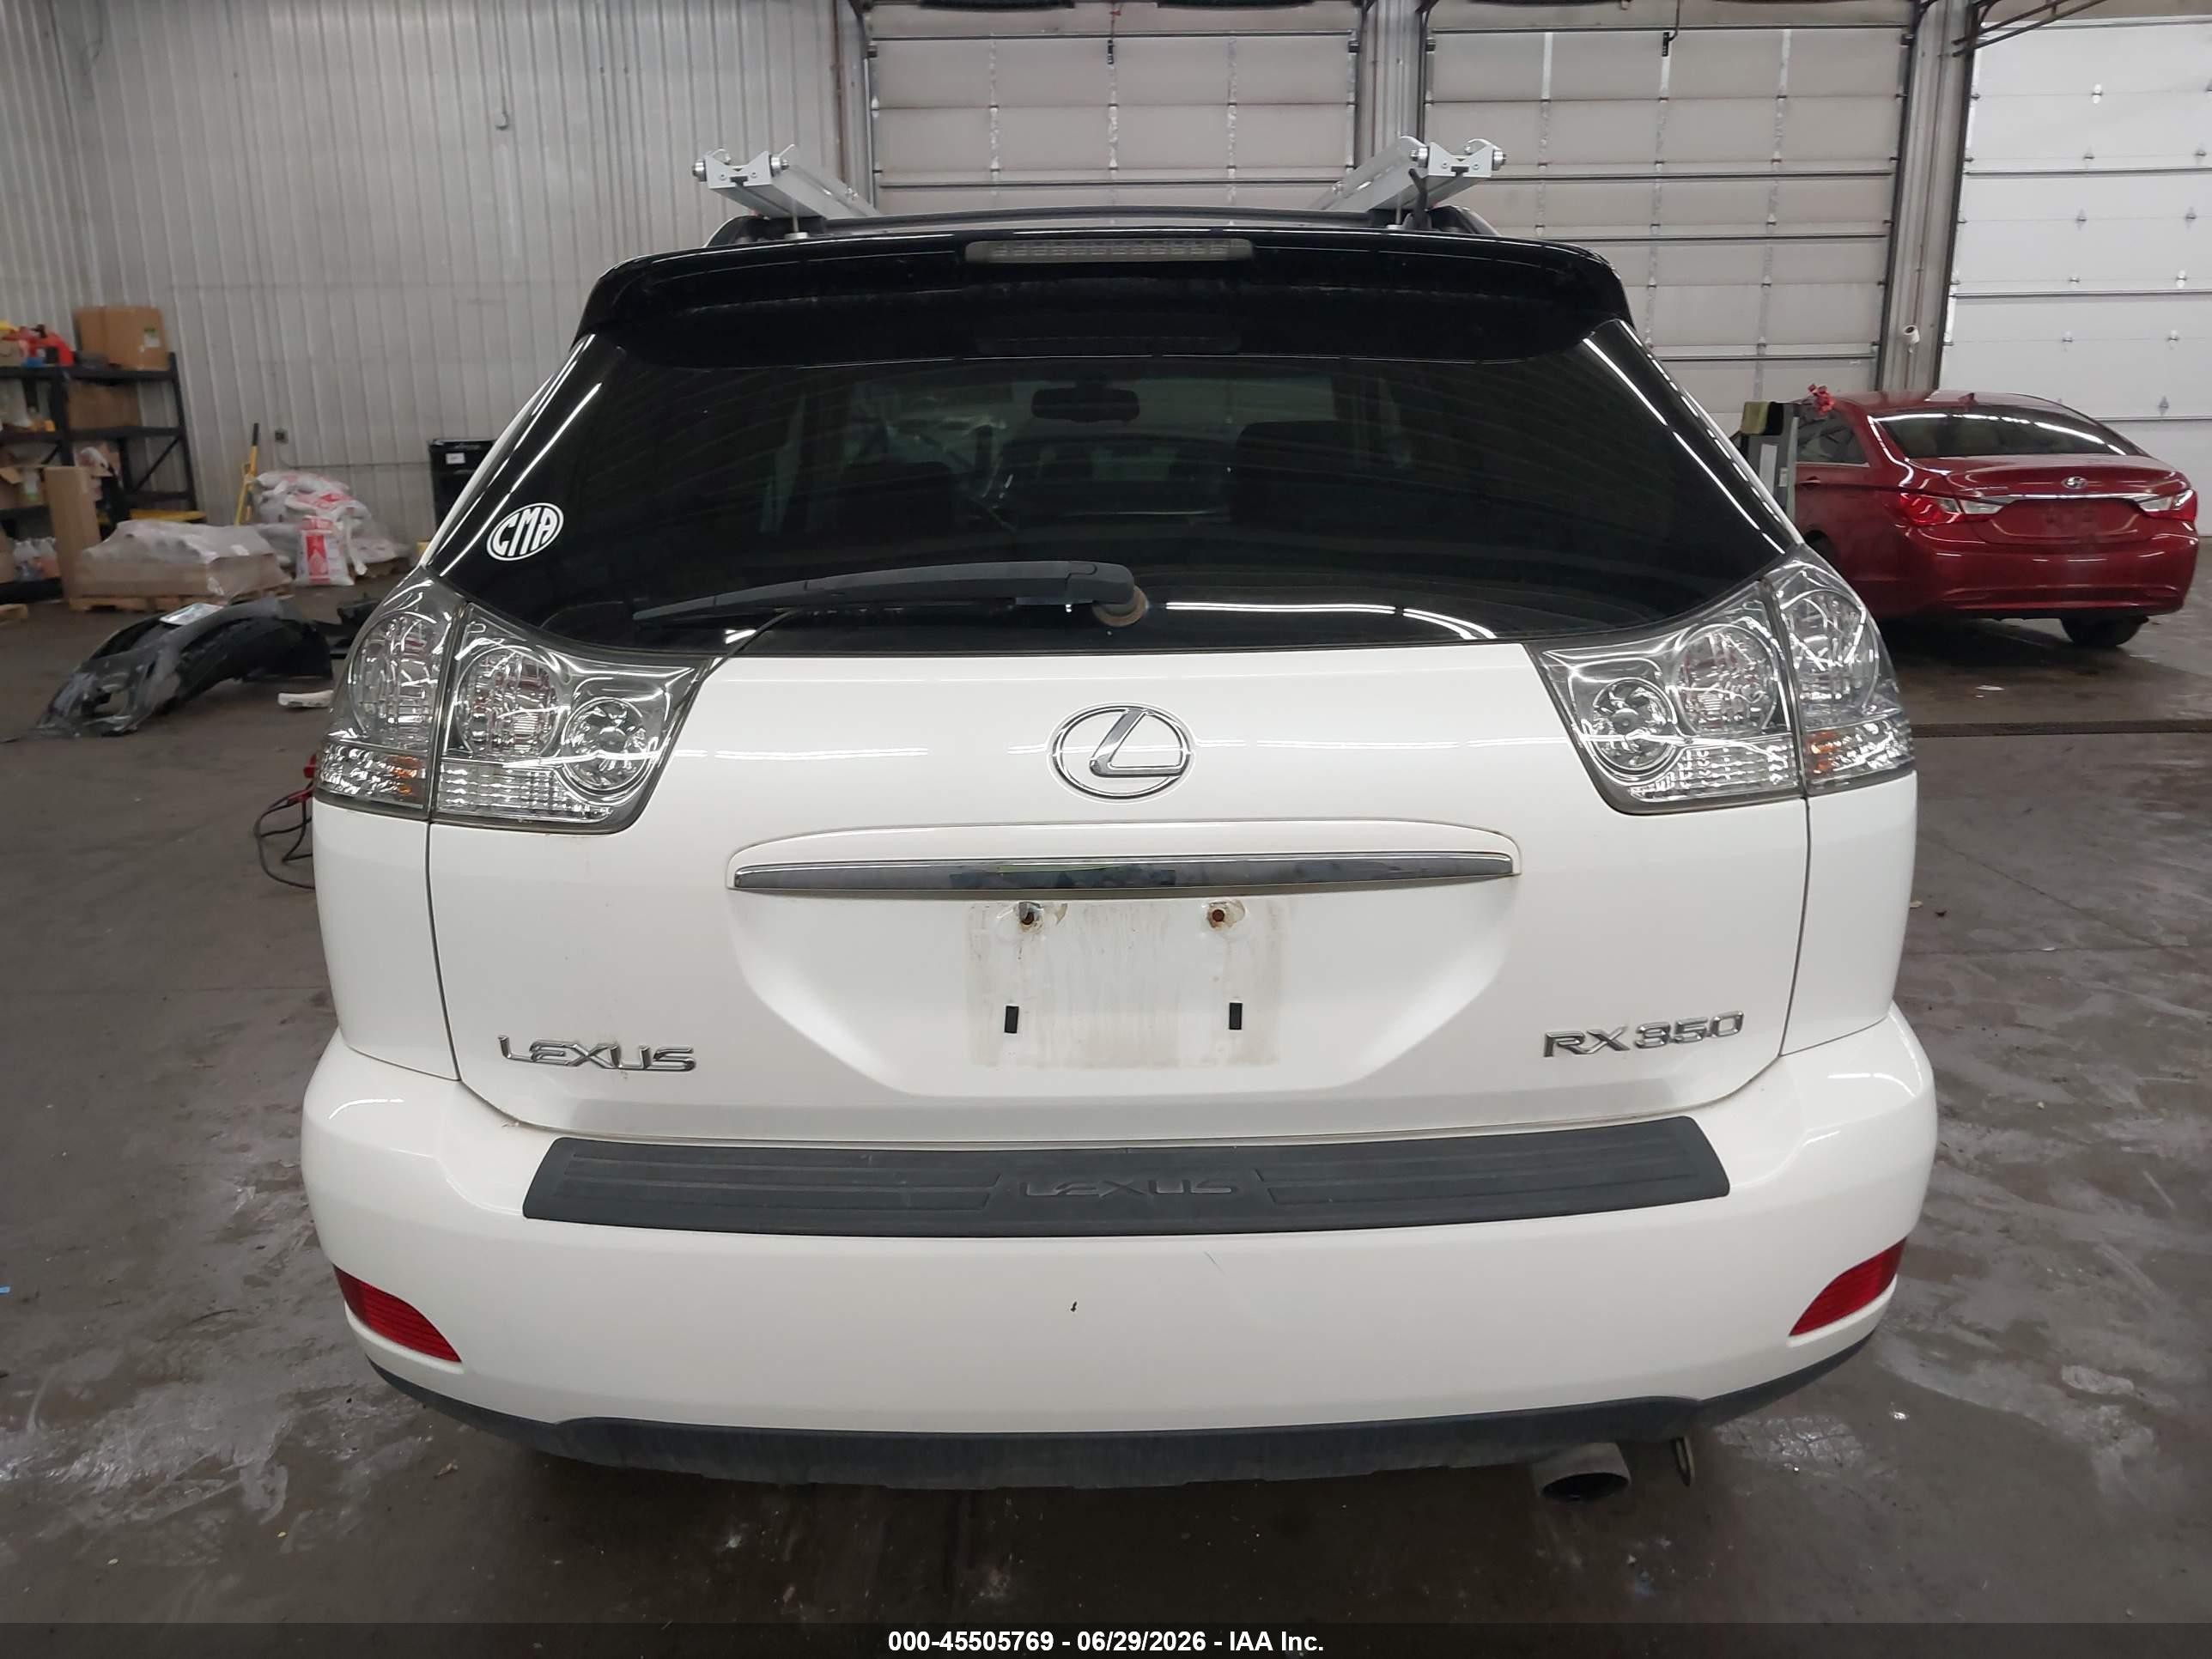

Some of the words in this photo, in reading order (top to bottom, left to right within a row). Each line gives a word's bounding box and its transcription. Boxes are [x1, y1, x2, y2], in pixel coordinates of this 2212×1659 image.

[492, 507, 558, 556] CMA
[498, 1035, 696, 1072] LEXUS
[1543, 1026, 1630, 1057] RX
[1635, 1010, 1744, 1048] 350
[1019, 1180, 1237, 1197] LEXUS
